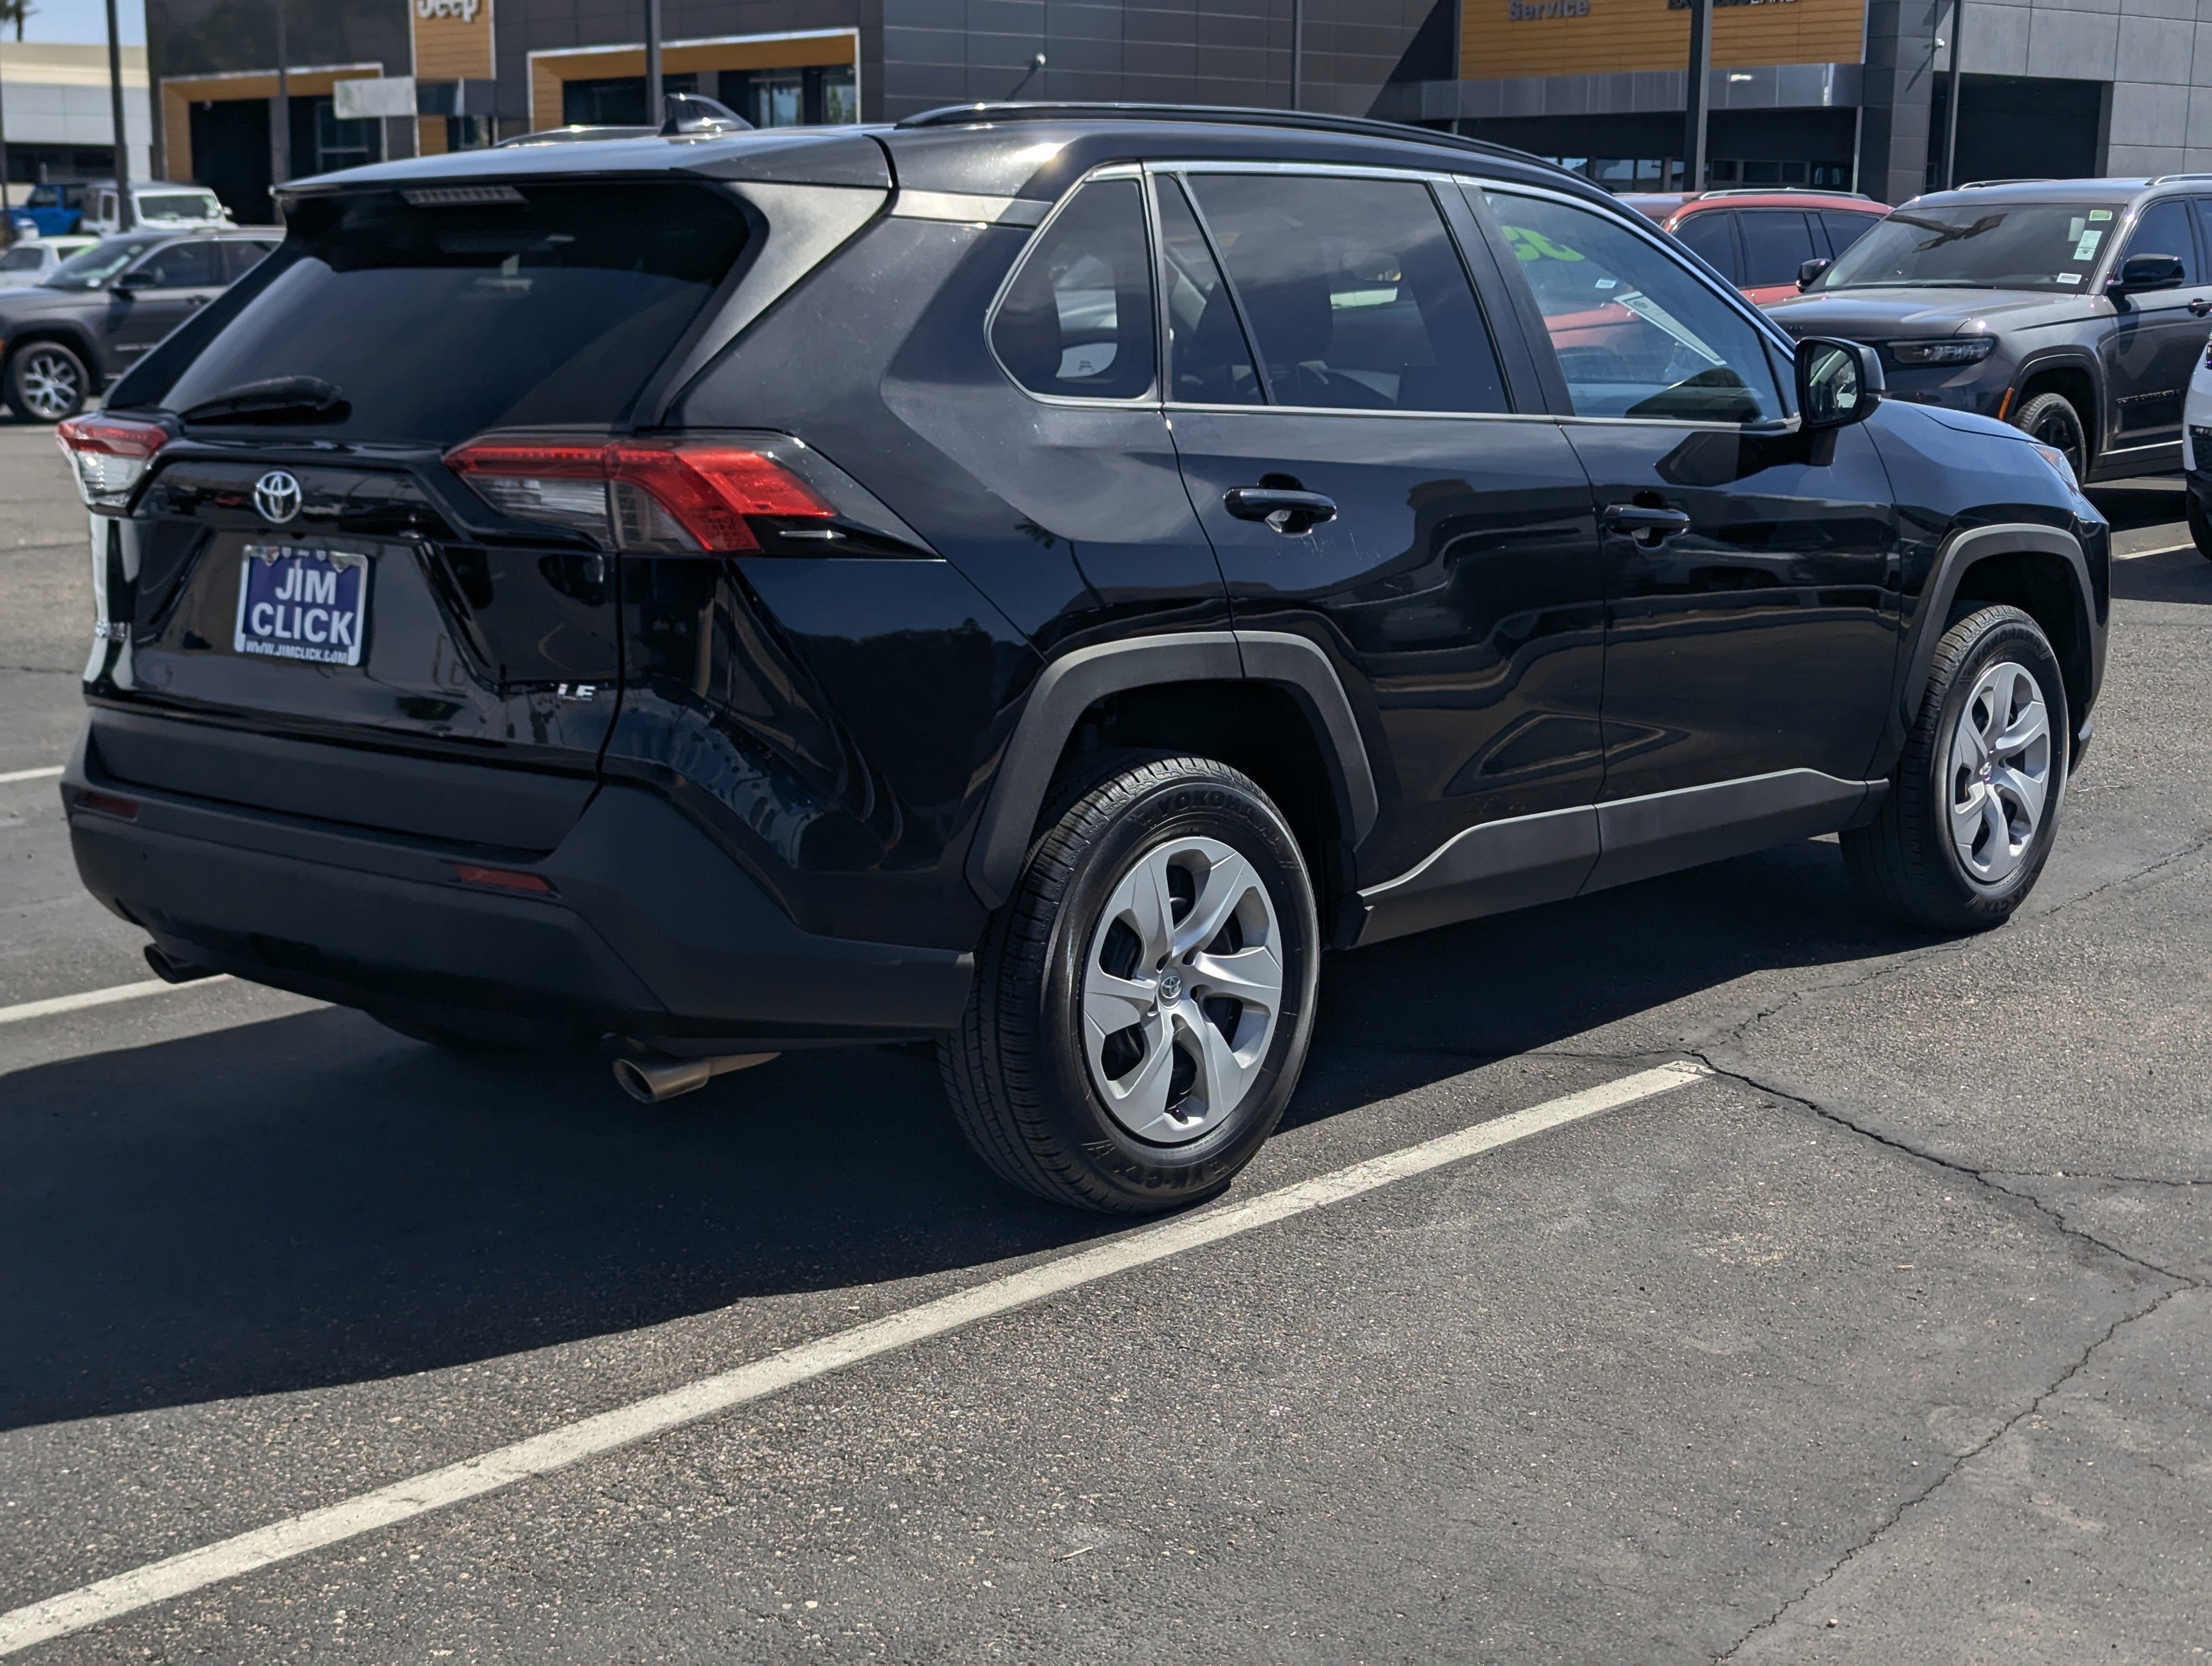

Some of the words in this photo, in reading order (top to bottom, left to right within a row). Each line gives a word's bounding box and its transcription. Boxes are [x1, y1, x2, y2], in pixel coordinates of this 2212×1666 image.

[1509, 0, 1589, 21] Service
[275, 568, 337, 605] JIM
[251, 602, 354, 646] CLICK
[557, 683, 596, 702] LE
